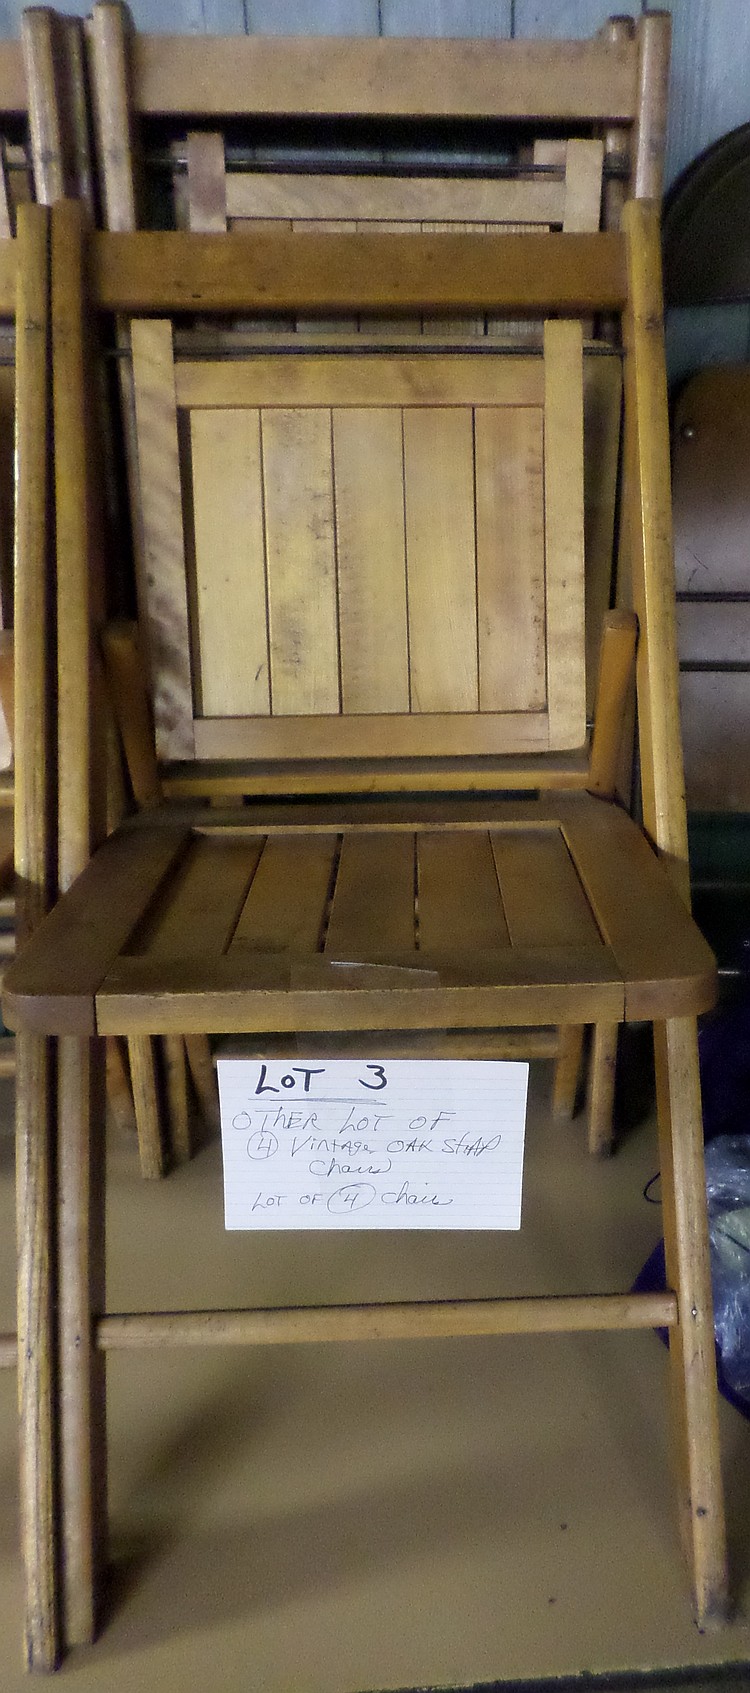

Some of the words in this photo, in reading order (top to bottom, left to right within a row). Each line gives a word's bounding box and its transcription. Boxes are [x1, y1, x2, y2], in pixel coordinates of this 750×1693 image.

[358, 1064, 388, 1091] 3
[408, 1111, 457, 1131] OF
[386, 1137, 434, 1153] OAK
[299, 1193, 324, 1206] OF
